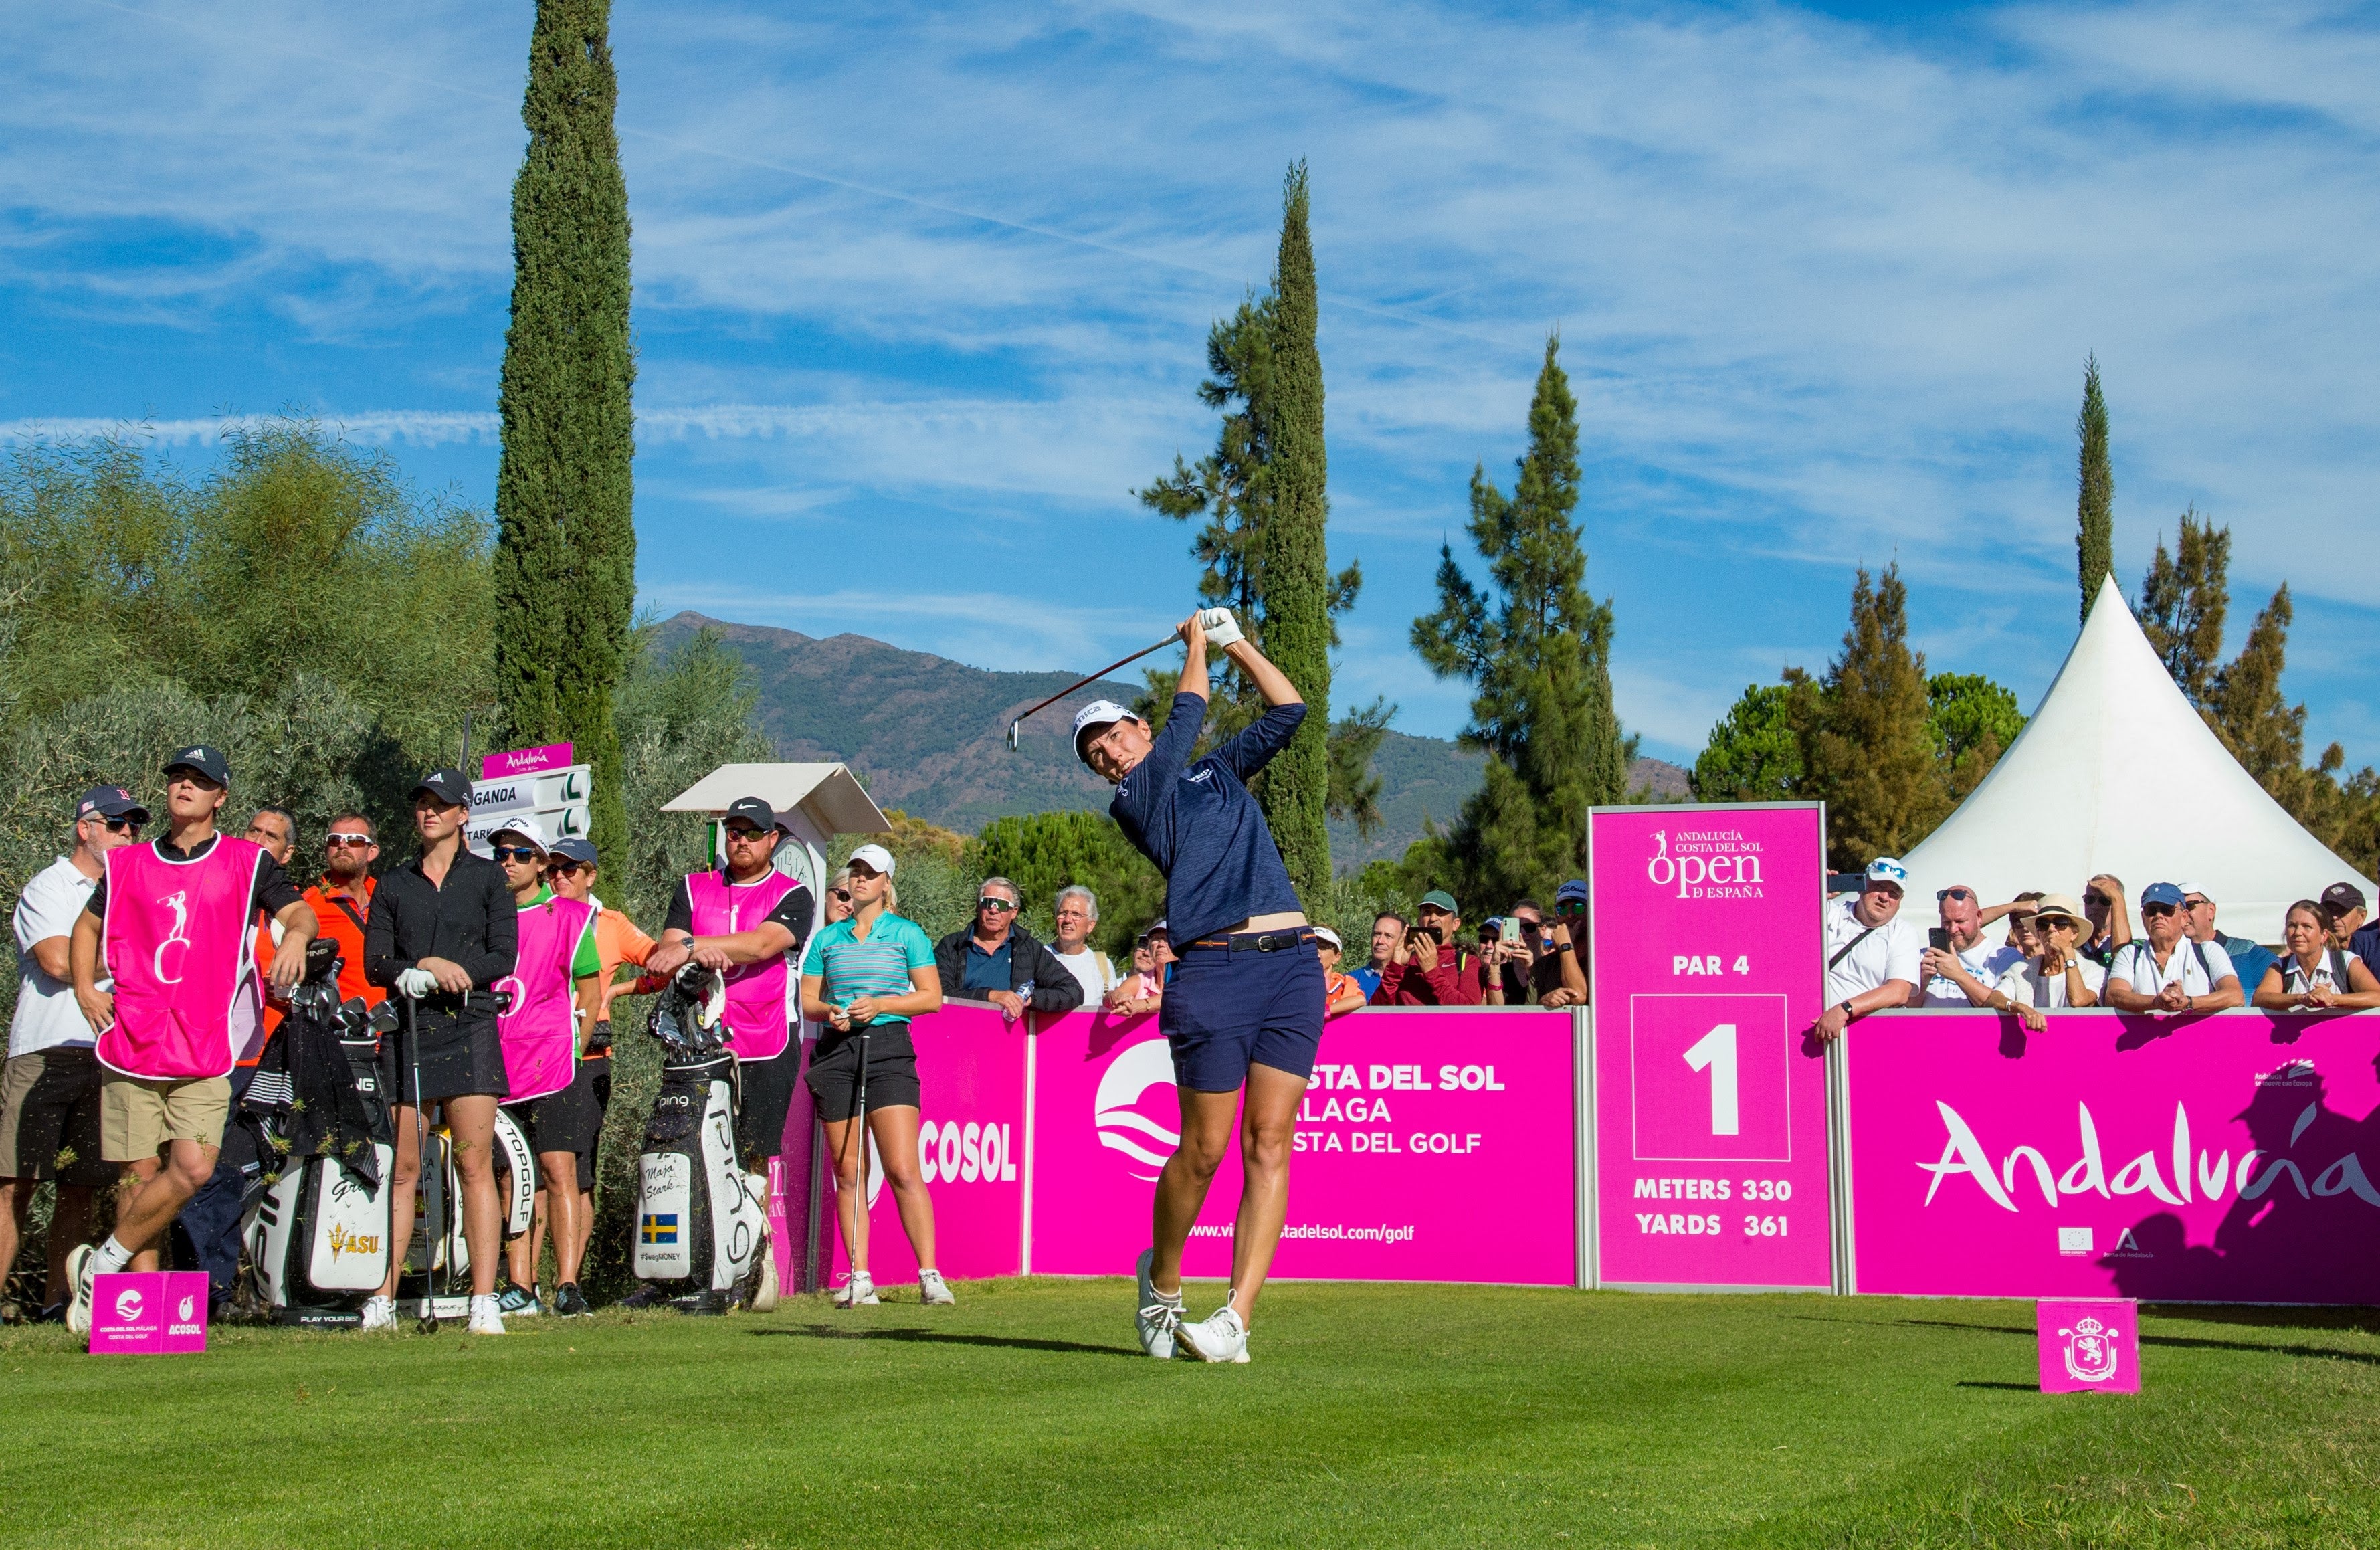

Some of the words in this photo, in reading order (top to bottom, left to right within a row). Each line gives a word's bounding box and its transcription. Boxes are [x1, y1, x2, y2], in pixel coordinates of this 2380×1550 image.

[472, 787, 516, 806] GANDA
[468, 828, 493, 840] TARK
[1675, 830, 1743, 842] ANDALUCÍA
[1676, 844, 1713, 852] COSTA
[1716, 844, 1739, 852] DEL
[1740, 843, 1763, 852] SOL
[1648, 856, 1764, 898] open
[1707, 885, 1764, 898] ESPAÑA
[1673, 955, 1723, 975] PAR
[1733, 955, 1749, 975] 4
[356, 1078, 375, 1092] NG
[1306, 1064, 1362, 1090] STA
[1369, 1065, 1432, 1090] DEL
[1439, 1065, 1505, 1091] SOL
[1682, 1024, 1739, 1135] 1
[659, 1096, 689, 1108] ping
[1296, 1098, 1392, 1123] LAGA
[918, 1120, 1016, 1183] COSOL
[1292, 1132, 1343, 1152] STA
[1351, 1133, 1402, 1153] DEL
[1409, 1133, 1482, 1153] GOLF
[1915, 1100, 2380, 1213] Andalucía
[506, 1128, 532, 1222] TOPGOLF
[645, 1164, 674, 1181] Maja
[646, 1179, 674, 1199] Stark
[1633, 1179, 1731, 1200] METERS
[1742, 1179, 1792, 1201] 330
[1635, 1214, 1721, 1236] YARDS
[1744, 1215, 1787, 1236] 361
[345, 1236, 379, 1254] ASU
[169, 1325, 201, 1335] ACOSOL
